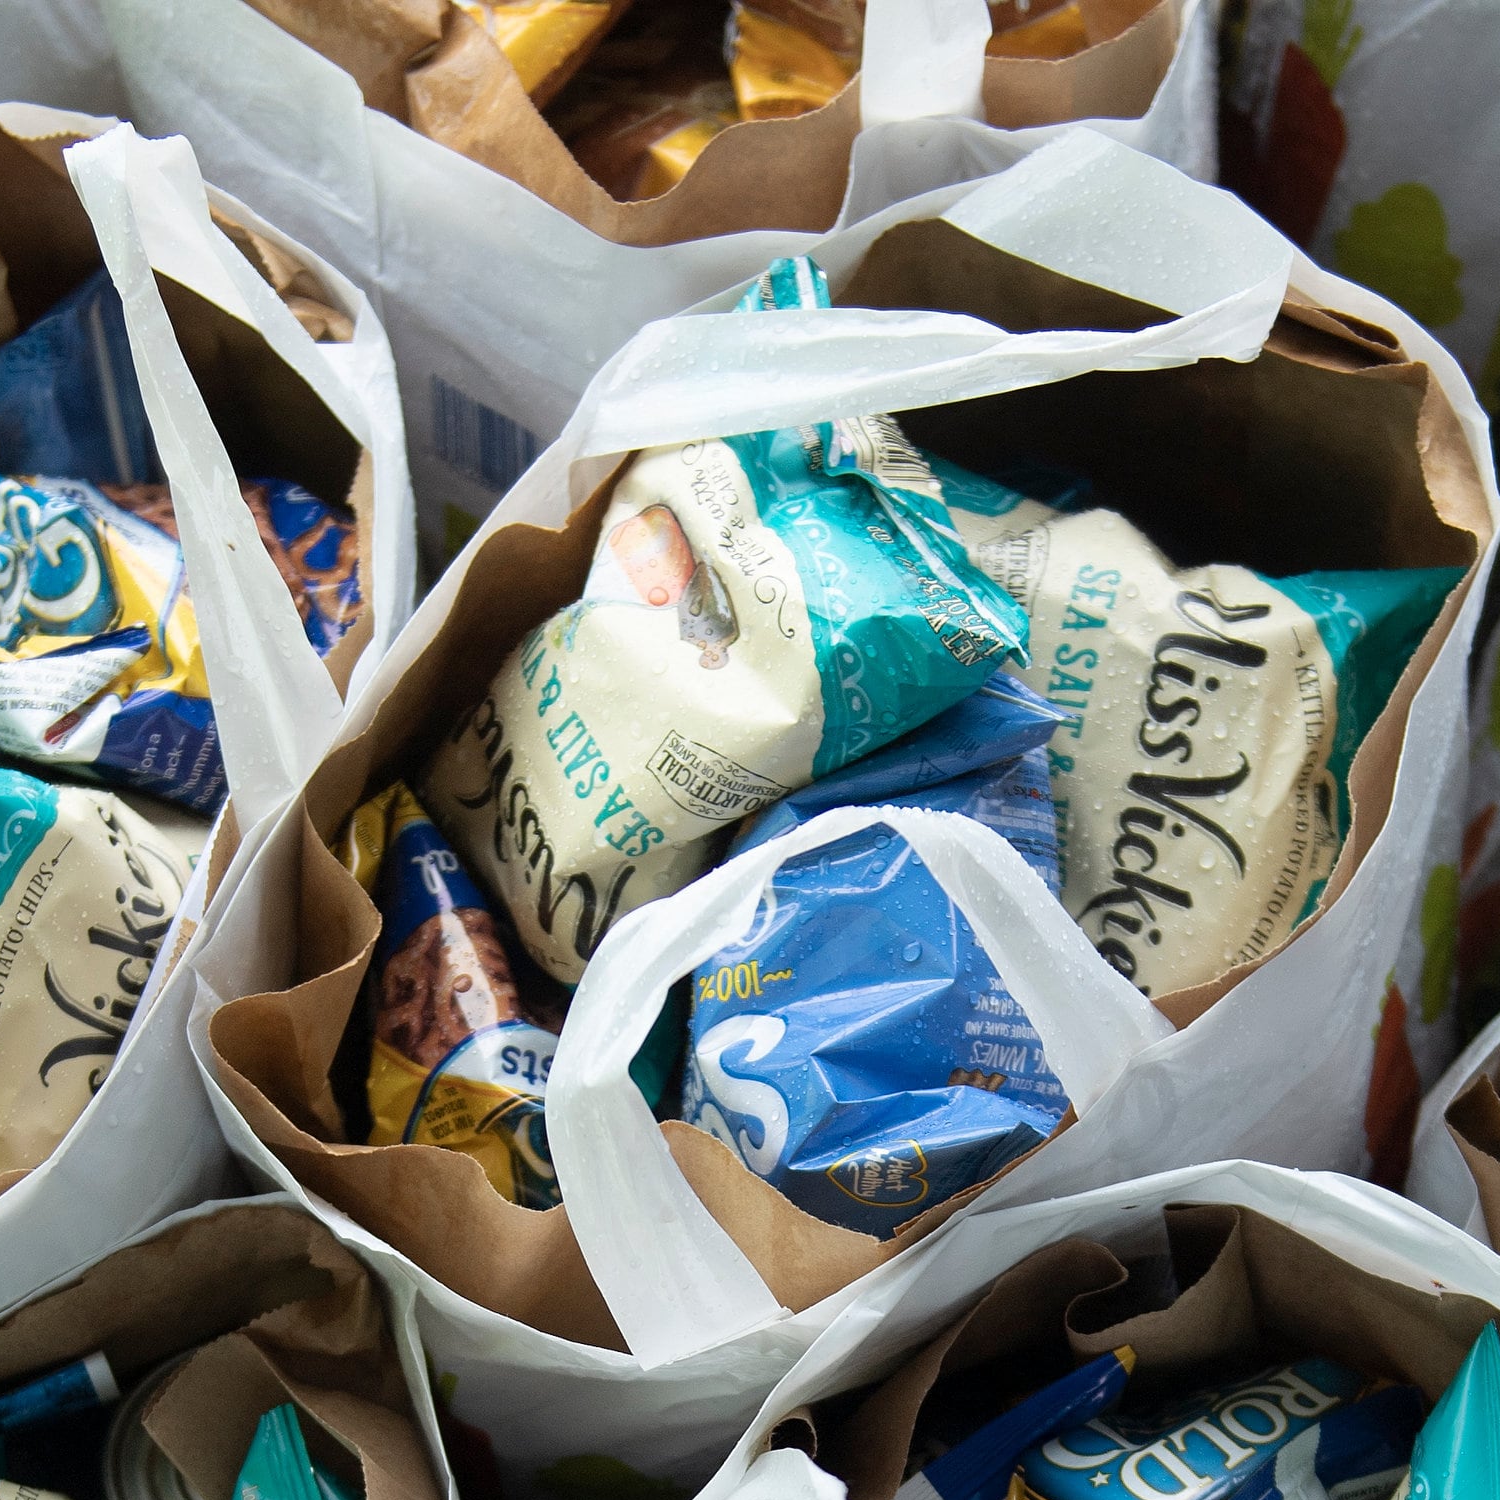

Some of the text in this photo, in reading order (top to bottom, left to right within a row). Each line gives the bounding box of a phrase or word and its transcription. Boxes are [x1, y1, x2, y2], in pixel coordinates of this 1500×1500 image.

[916, 600, 982, 666] NET WT
[938, 595, 969, 615] OZ
[1047, 564, 1123, 779] SEA SALT &
[1138, 588, 1272, 770] Miss
[533, 665, 666, 860] SEA SALT &
[654, 749, 744, 810] ARTIFICIAL
[668, 736, 700, 770] FLAVORS
[1266, 662, 1326, 914] KETTLE COOKED POTATO
[14, 861, 55, 928] CHIPS
[968, 1041, 1027, 1067] WAVES
